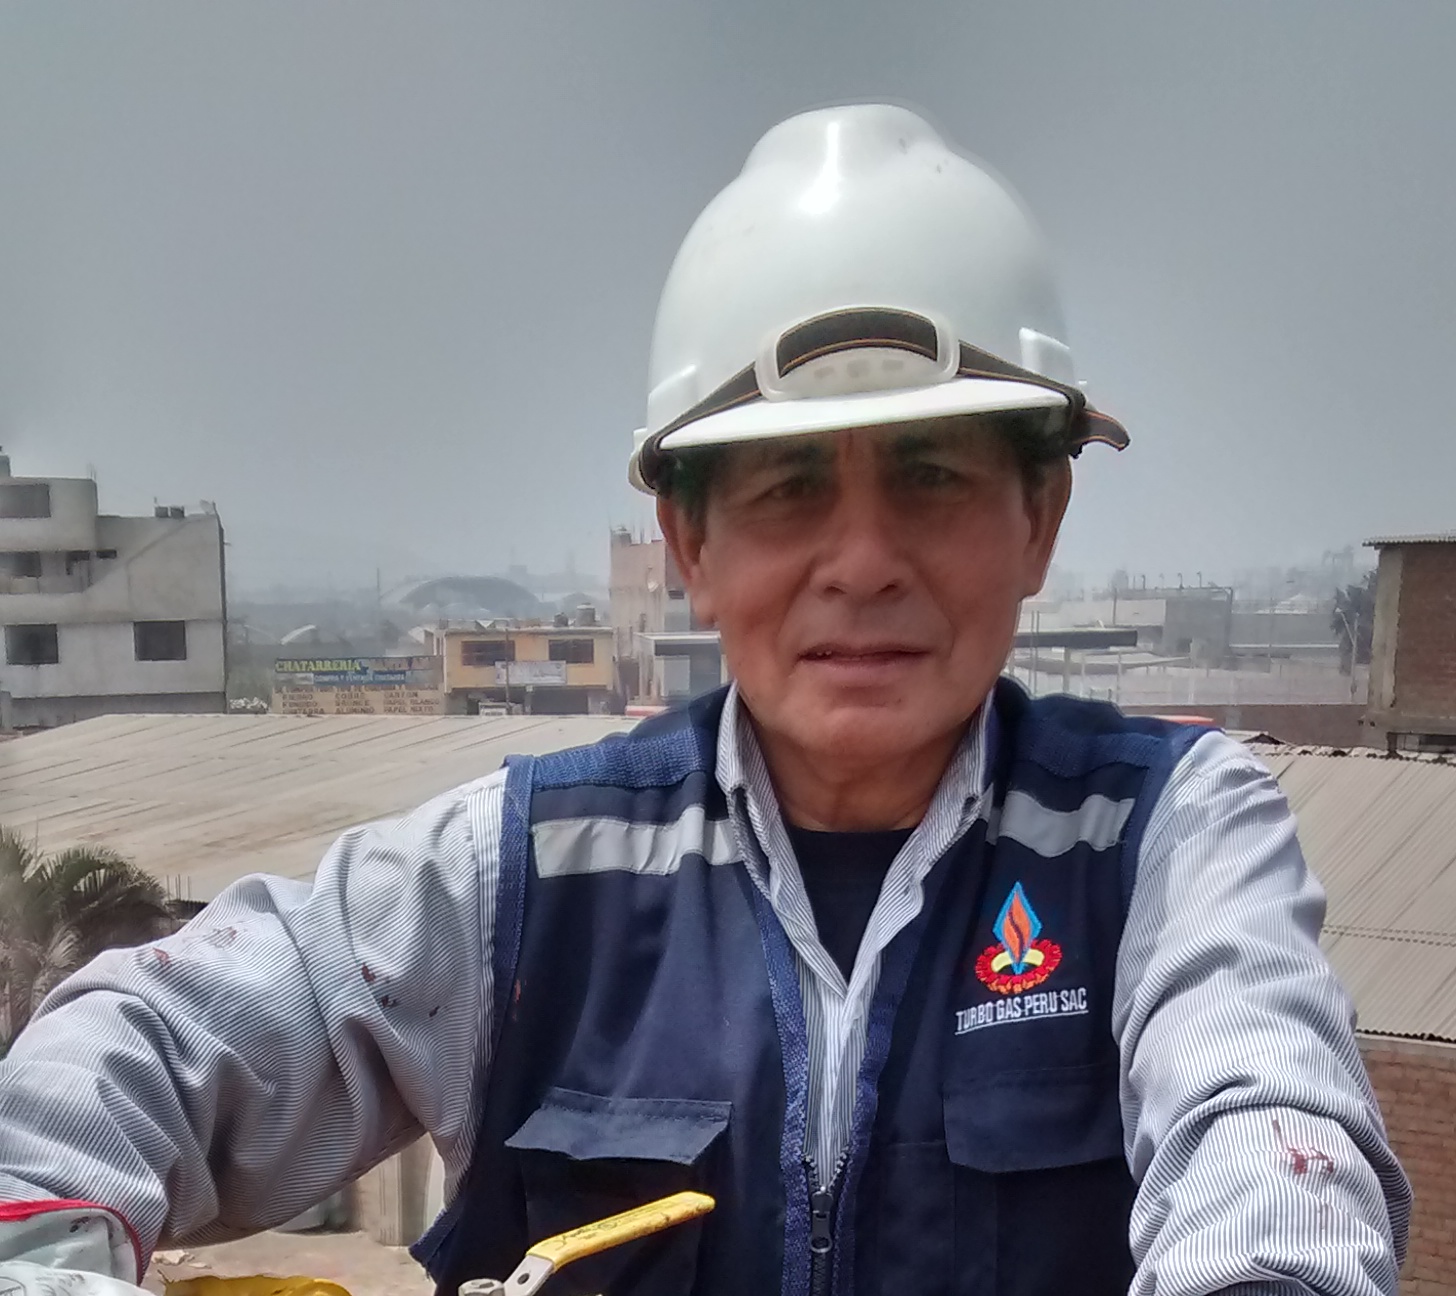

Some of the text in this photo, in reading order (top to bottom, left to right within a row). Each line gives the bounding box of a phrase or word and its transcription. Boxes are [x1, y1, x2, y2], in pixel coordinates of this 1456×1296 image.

[275, 659, 361, 672] CHATARRERIA
[955, 987, 1087, 1031] TURBO GAS PERU SAC
